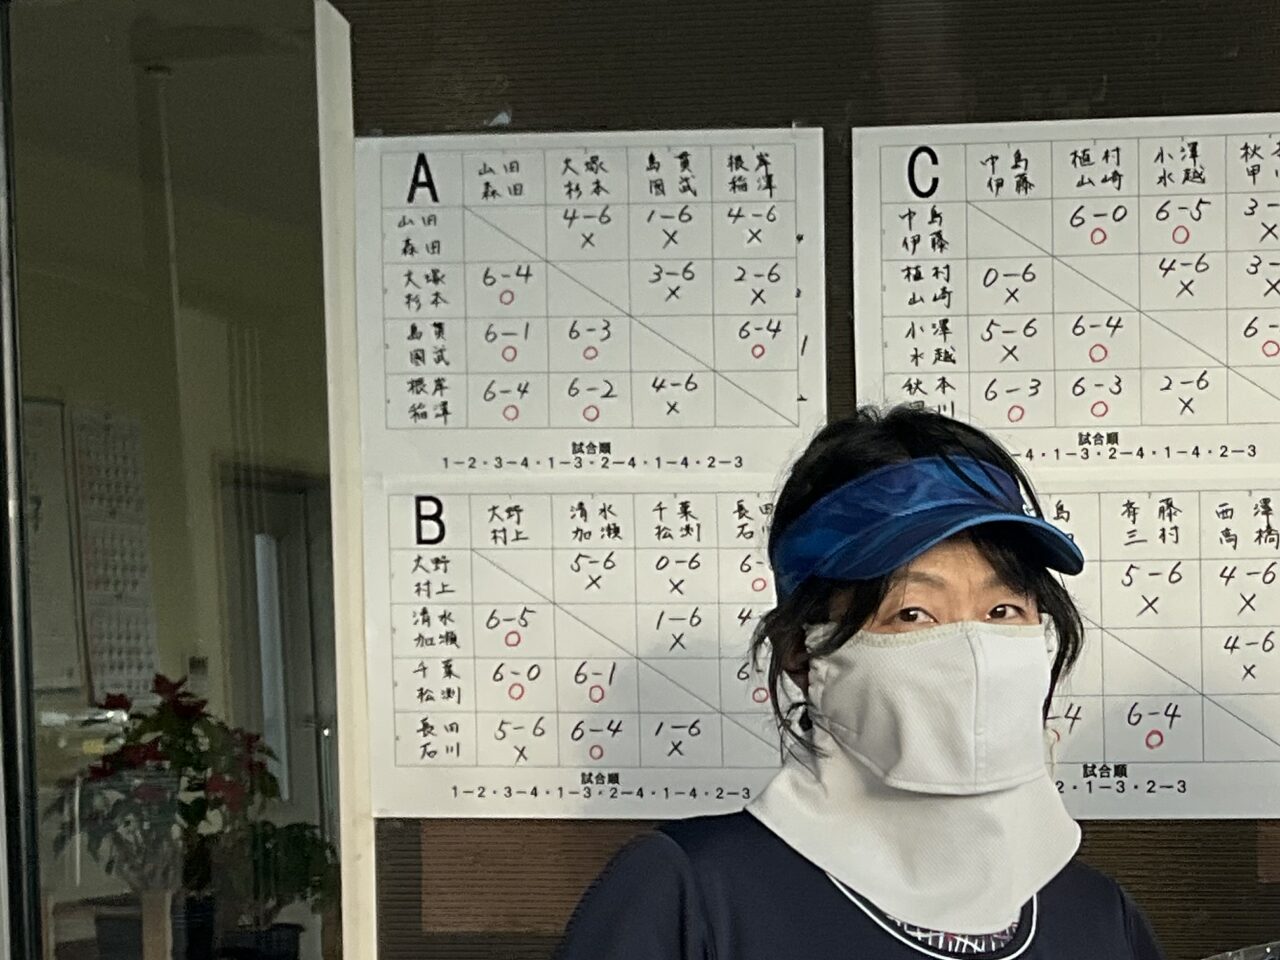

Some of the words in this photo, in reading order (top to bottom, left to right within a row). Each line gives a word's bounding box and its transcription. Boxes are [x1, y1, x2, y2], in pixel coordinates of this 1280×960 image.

[407, 153, 439, 203] A
[908, 146, 939, 198] C
[987, 173, 1034, 195] 伊藤
[563, 206, 611, 227] 4-6
[647, 206, 692, 223] 1-6
[728, 206, 776, 224] 4-6
[1070, 205, 1127, 229] 6-0
[1156, 198, 1211, 221] 6-5
[903, 231, 949, 253] 伊藤
[649, 262, 694, 283] 3-6
[735, 263, 780, 282] 2-6
[983, 263, 1035, 286] 0-6
[1159, 253, 1209, 276] 4-6
[483, 265, 532, 286] 6-4
[485, 322, 529, 343] 6-1
[569, 320, 610, 341] 6-3
[739, 319, 781, 338] 6-4
[981, 318, 1037, 341] 5-6
[1072, 316, 1123, 336] 6-4
[484, 380, 529, 400] 6-4
[568, 378, 617, 398] 6-2
[652, 374, 697, 392] 4-6
[985, 379, 1041, 401] 6-3
[1072, 375, 1122, 396] 6-3
[1160, 370, 1209, 391] 2-6
[572, 442, 611, 454] 試合順
[1079, 432, 1118, 445] 試合順
[415, 495, 445, 545] B
[491, 527, 528, 545] 村上
[1124, 526, 1178, 545] 三村
[571, 553, 615, 572] 5-6
[656, 553, 700, 570] 0-6
[1122, 561, 1182, 586] 5-6
[1220, 562, 1277, 585] 4-6
[415, 580, 455, 598] 村上
[486, 607, 536, 629] 6-5
[656, 608, 701, 629] 1-6
[1224, 631, 1274, 653] 4-6
[493, 663, 540, 682] 6-0
[575, 661, 616, 685] 6-1
[1128, 702, 1181, 728] 6-4
[495, 717, 545, 740] 5-6
[571, 720, 622, 740] 6-4
[655, 720, 700, 736] 1-6
[420, 742, 459, 759] 石川
[581, 772, 619, 784] 試合順
[1083, 763, 1127, 778] 試合順
